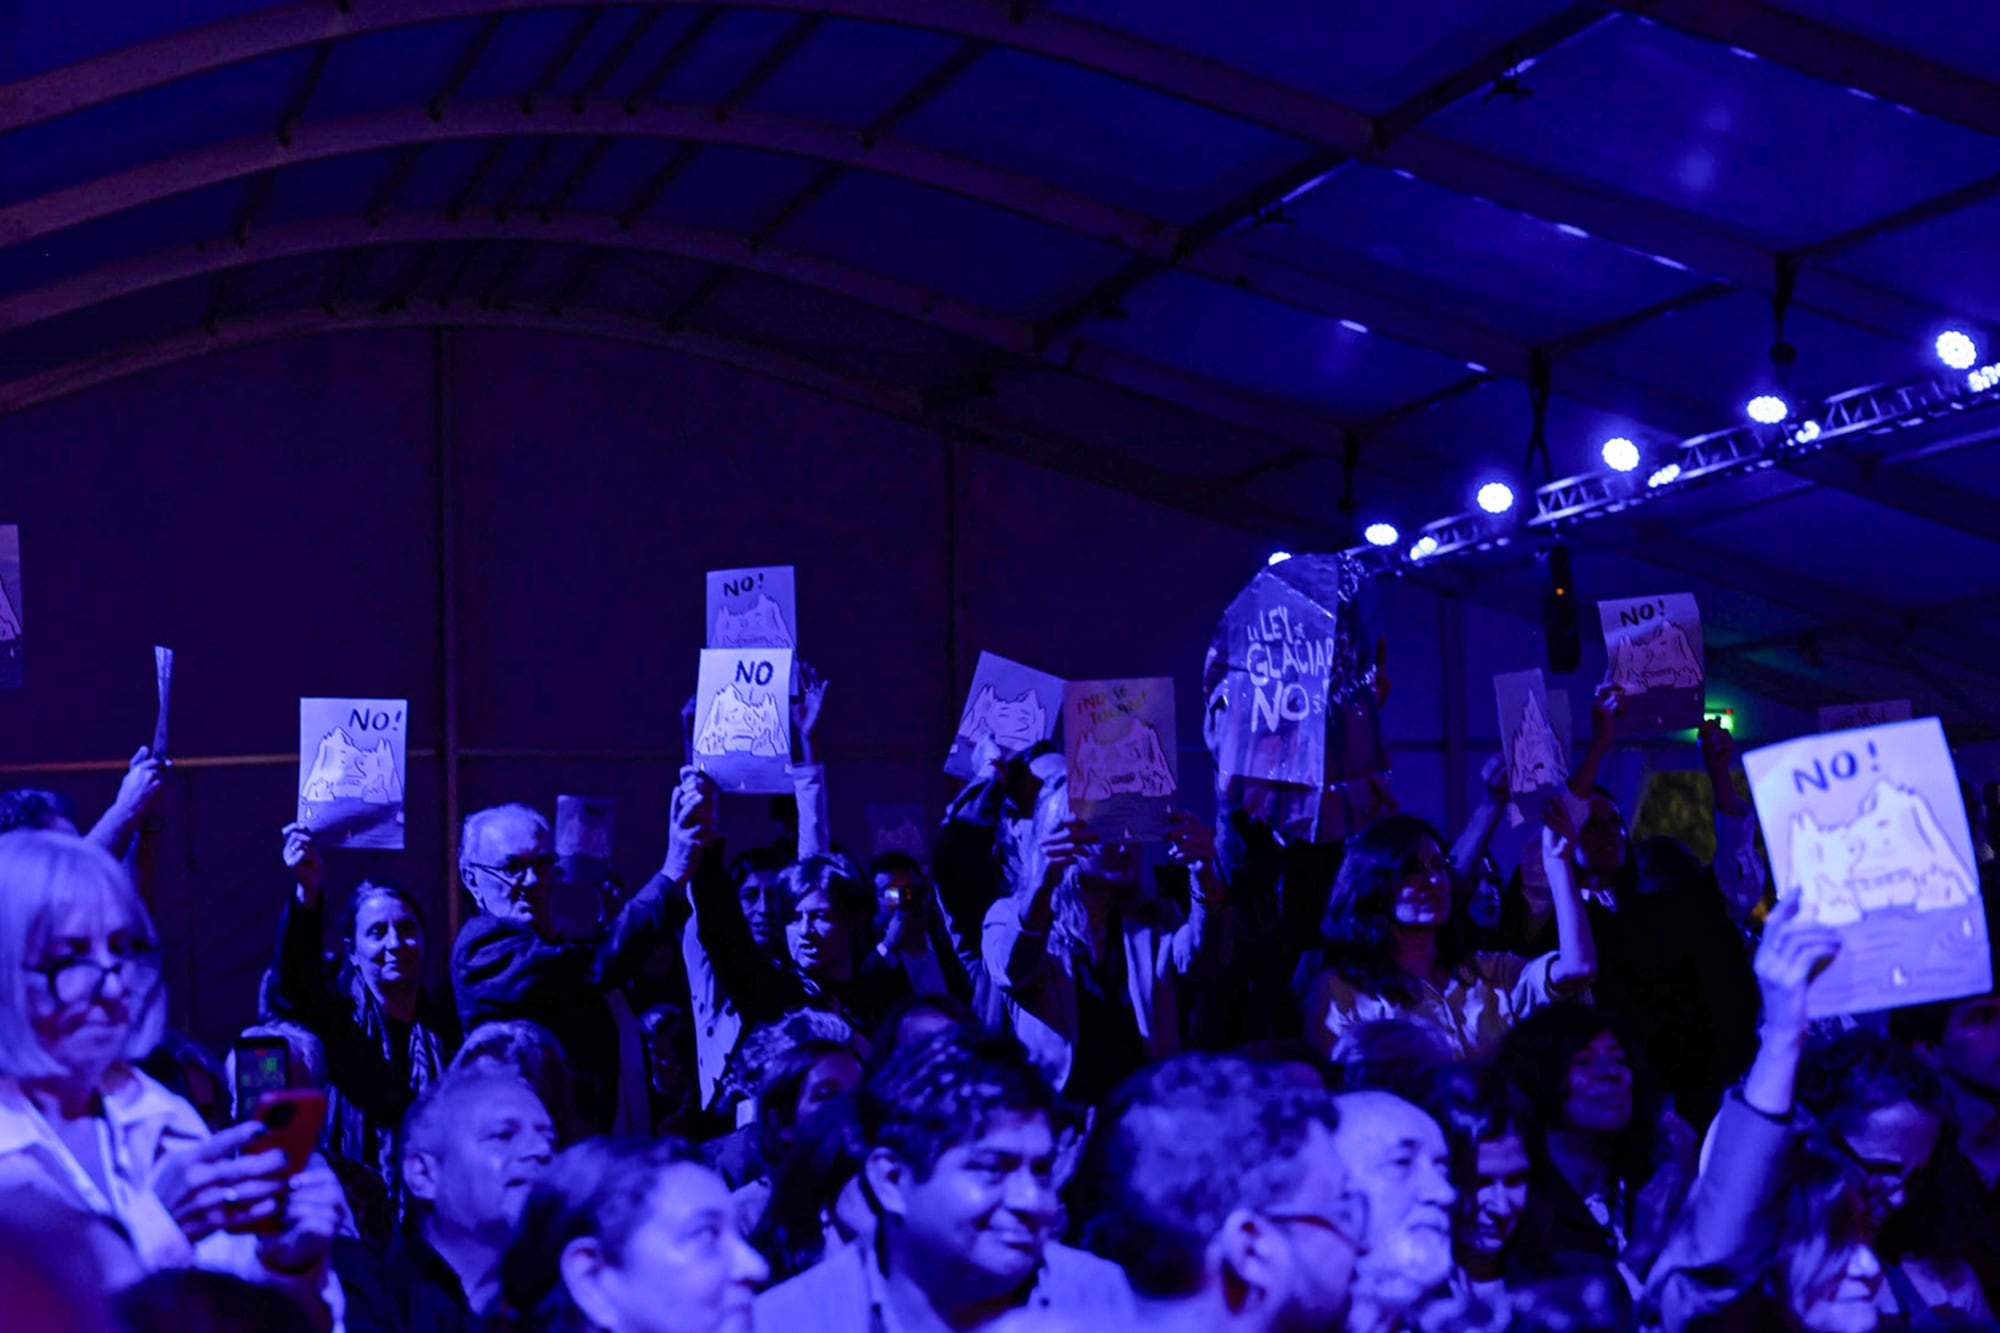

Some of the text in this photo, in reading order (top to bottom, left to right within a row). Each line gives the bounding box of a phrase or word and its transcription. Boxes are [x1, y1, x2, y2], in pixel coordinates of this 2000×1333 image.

[723, 571, 764, 597] NO!
[1260, 605, 1293, 645] LEY
[1619, 598, 1665, 627] NO!
[734, 659, 774, 686] NO
[348, 707, 402, 731] NO!
[1251, 679, 1309, 733] NO
[1791, 740, 1880, 794] NO!
